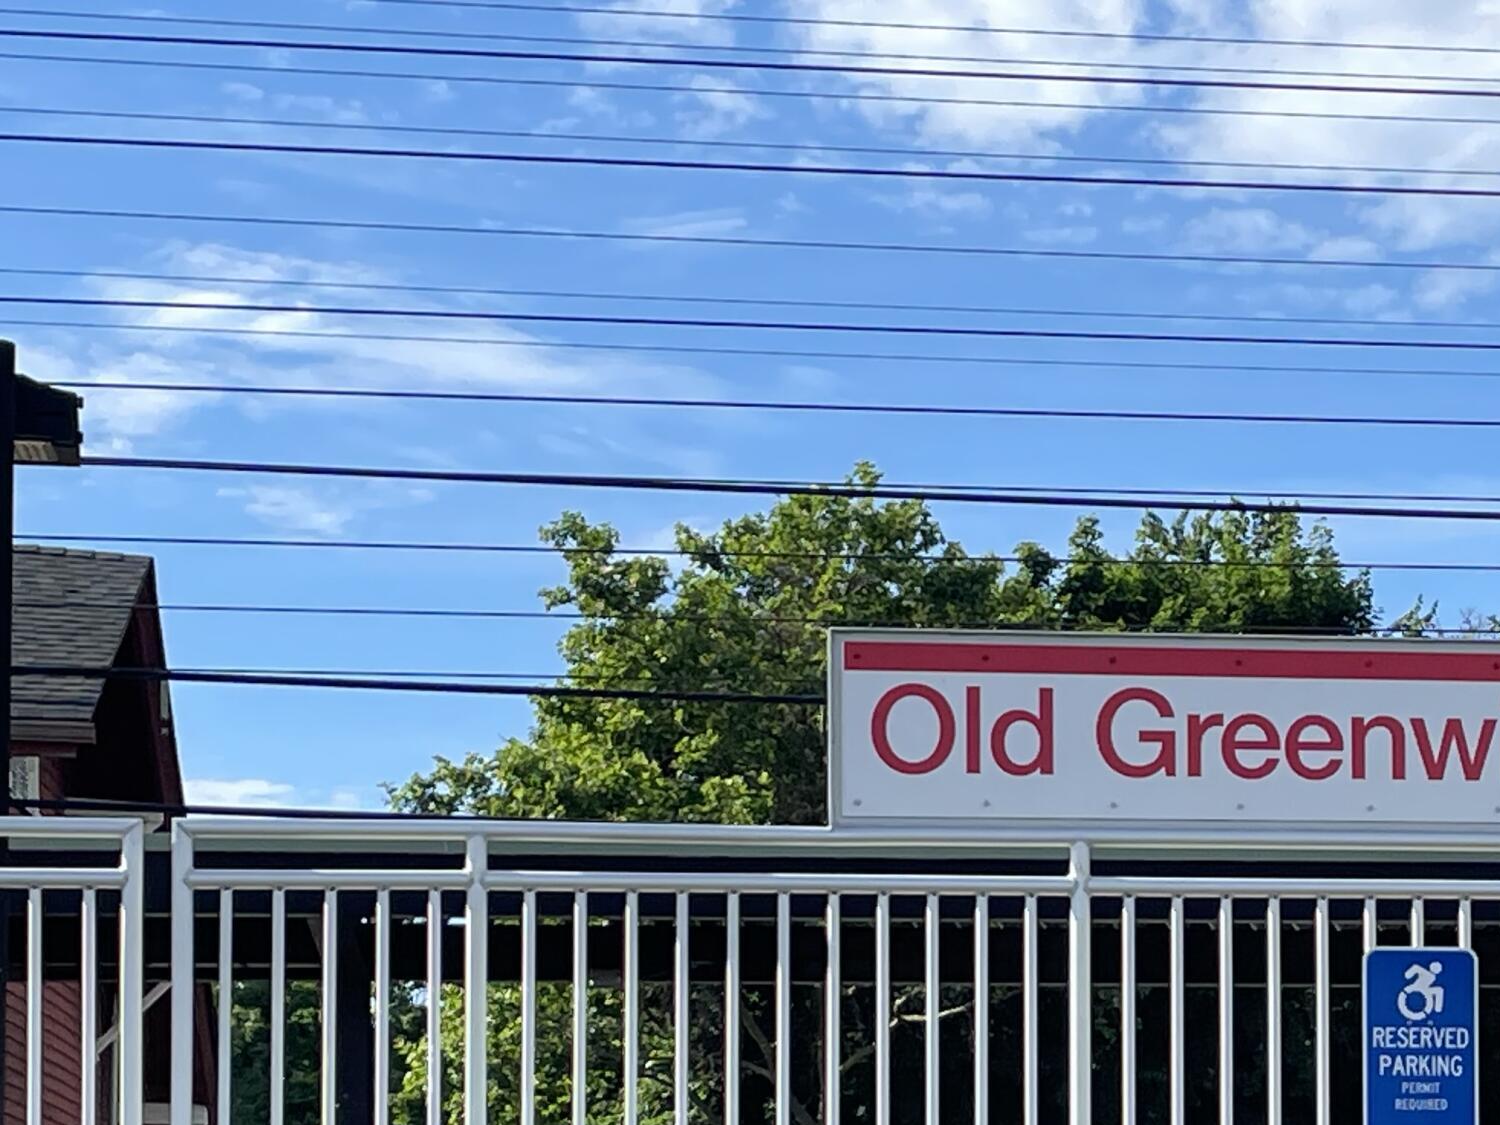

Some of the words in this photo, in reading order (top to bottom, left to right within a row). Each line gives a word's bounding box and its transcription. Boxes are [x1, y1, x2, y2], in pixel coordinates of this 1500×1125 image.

[871, 684, 1054, 776] Old
[1372, 1026, 1469, 1049] RESERVED
[1378, 1054, 1463, 1077] PARKING
